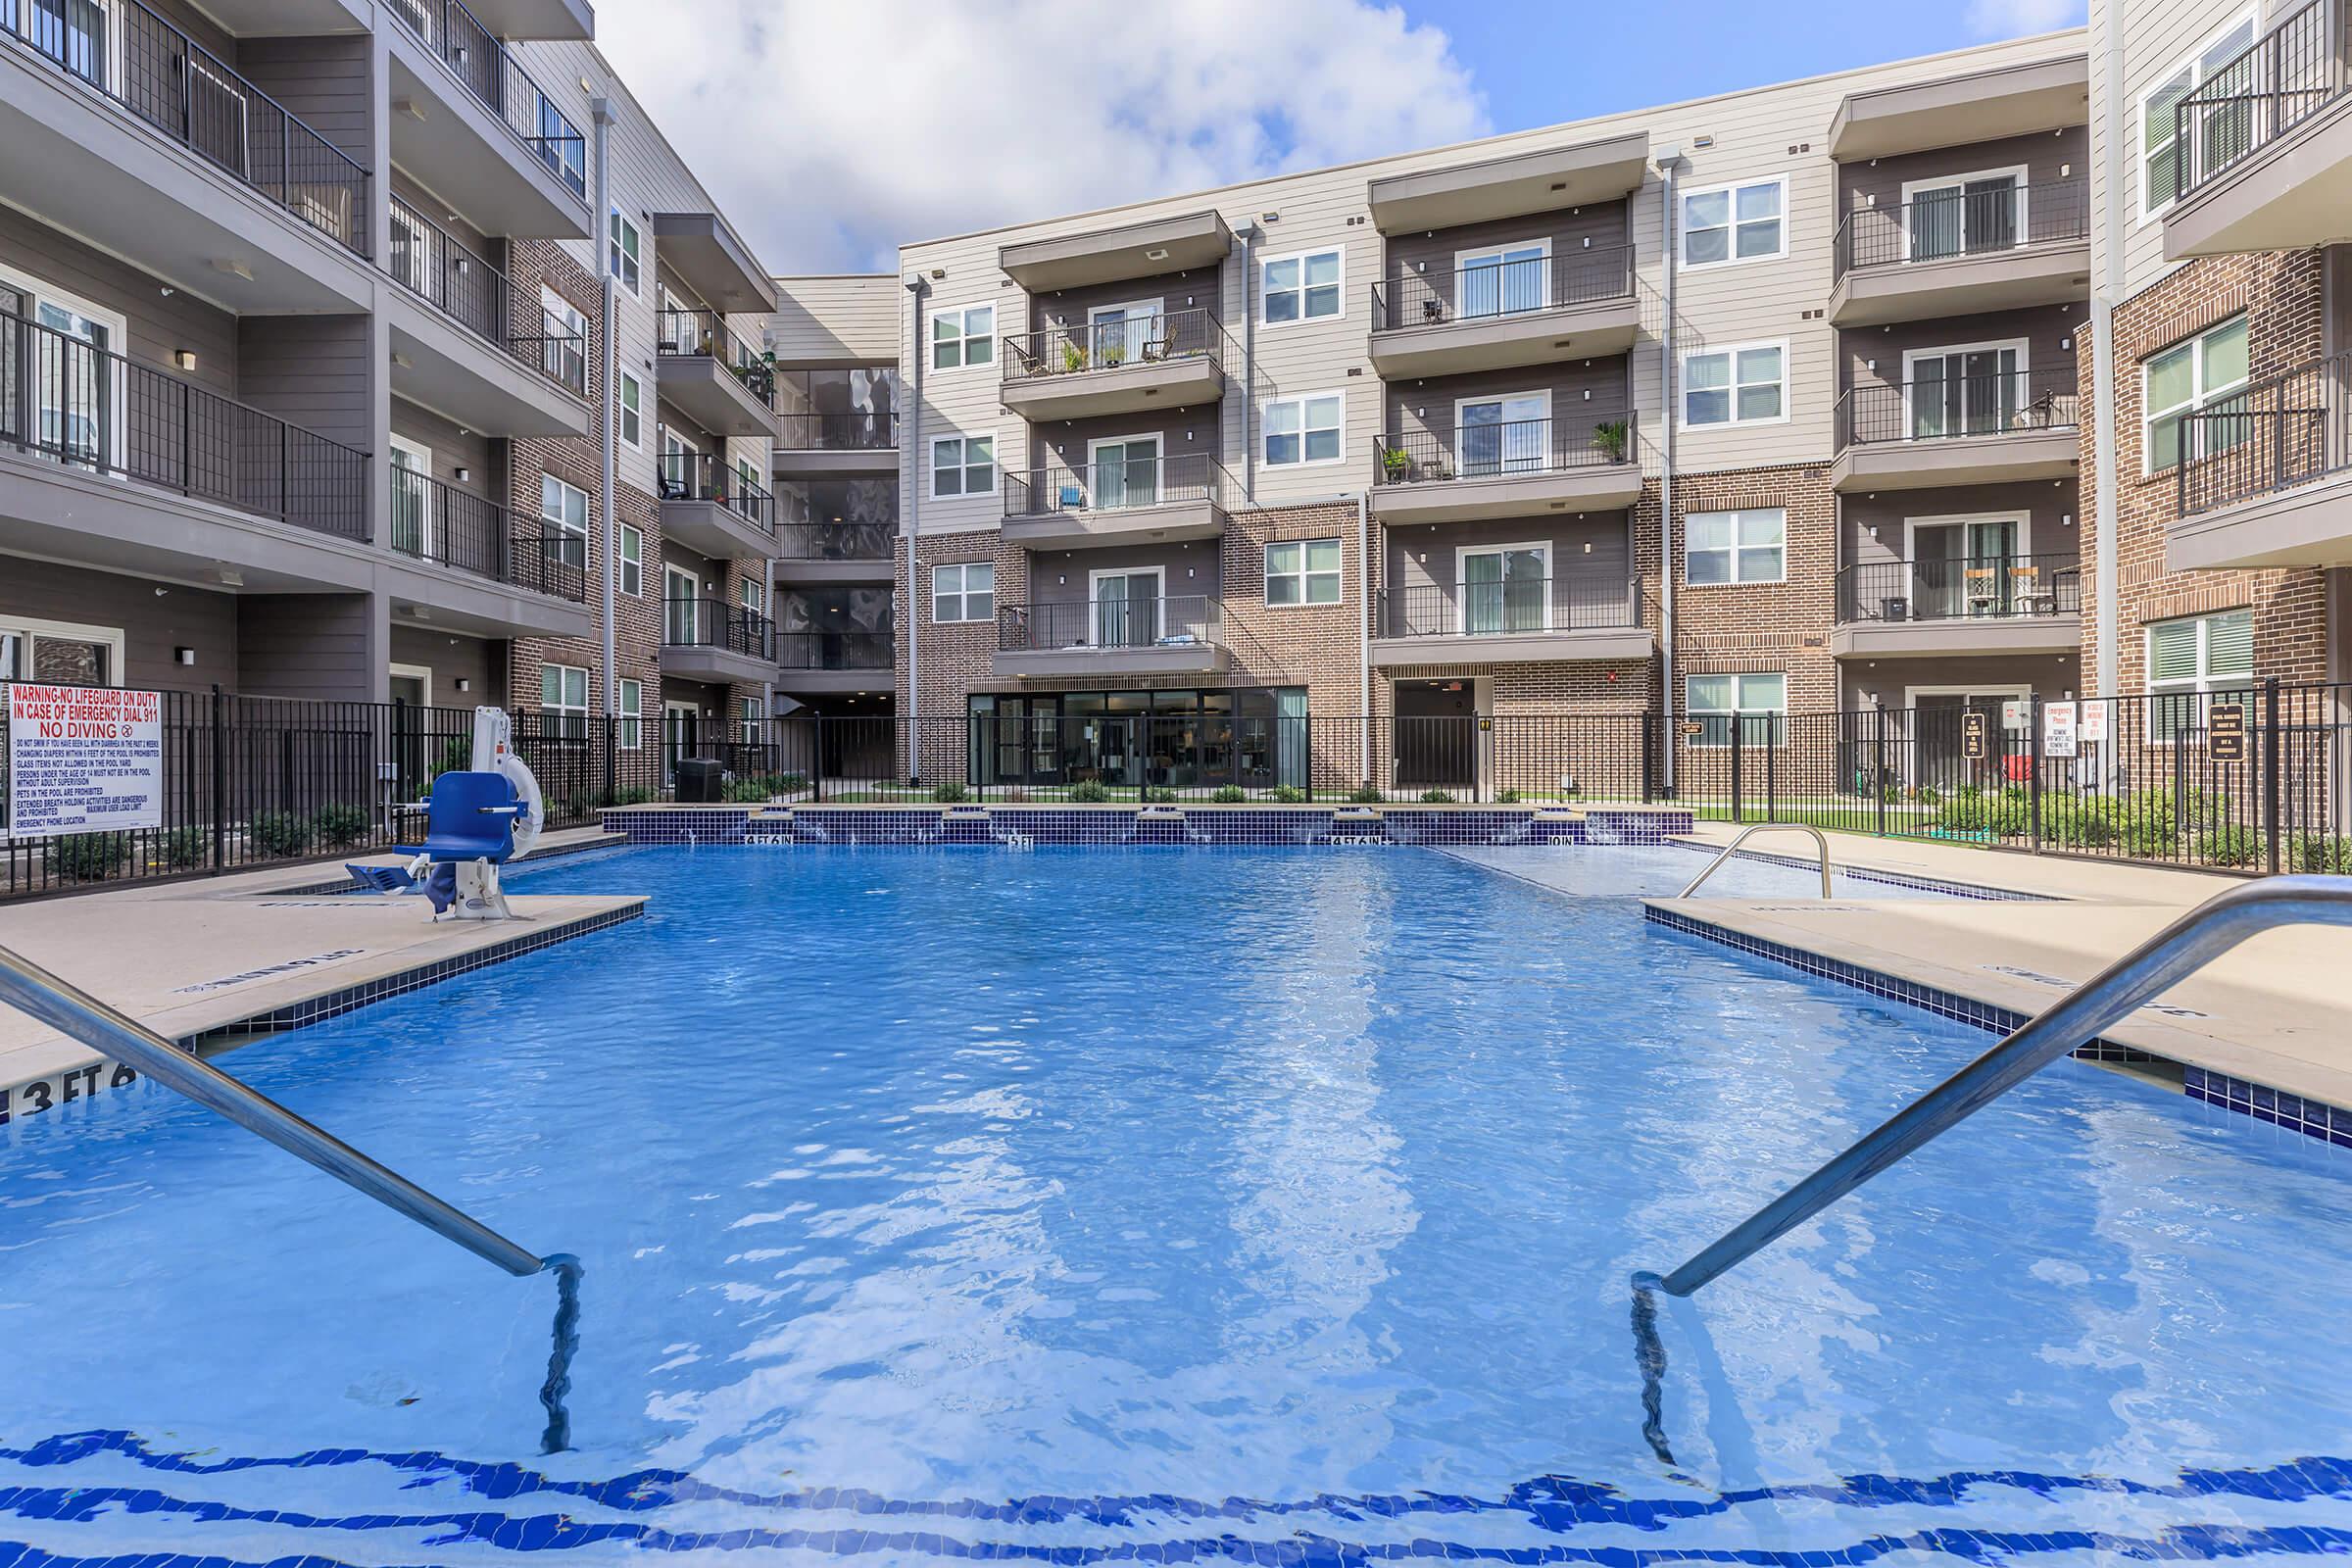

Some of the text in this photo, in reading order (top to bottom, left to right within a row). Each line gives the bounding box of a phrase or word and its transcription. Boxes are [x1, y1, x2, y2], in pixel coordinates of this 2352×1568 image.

[13, 685, 157, 707] WARNING-NO LIFEGUARD ON DUTY
[14, 703, 157, 722] IN CASE OF EMERGENCY DIAL 911
[40, 721, 117, 739] NO DIVING
[17, 759, 131, 768] GLASS ITEMS NOT ALLOWED IN THE POOL YARD
[17, 769, 40, 779] PERSONS
[41, 769, 58, 778] UNDER
[59, 768, 69, 778] THE
[70, 768, 79, 778] AGE
[80, 768, 86, 777] OF
[94, 768, 106, 777] MUST
[107, 768, 117, 777] NOT
[117, 768, 123, 777] BE
[124, 768, 129, 777] IN
[17, 777, 89, 788] WITHOUT ADULT SUPERVISION
[17, 787, 103, 799] PETS IN THE POOL ARE PROHIBITED
[17, 795, 148, 808] EXTENDED BREATH HOLDING ACTIVITIES ARE DANGEROUS
[17, 807, 58, 817] AND PROHIBITED
[86, 804, 107, 813] MAXIMUM
[108, 804, 119, 812] USER
[120, 803, 130, 811] LOAD
[17, 816, 85, 828] EMERGENCY PHONE LOCATION
[758, 835, 768, 845] FT
[770, 835, 780, 845] 6
[781, 835, 791, 845] IN
[1021, 835, 1032, 846] FT
[1562, 836, 1572, 846] IN
[22, 1062, 136, 1116] 3 FT 6
